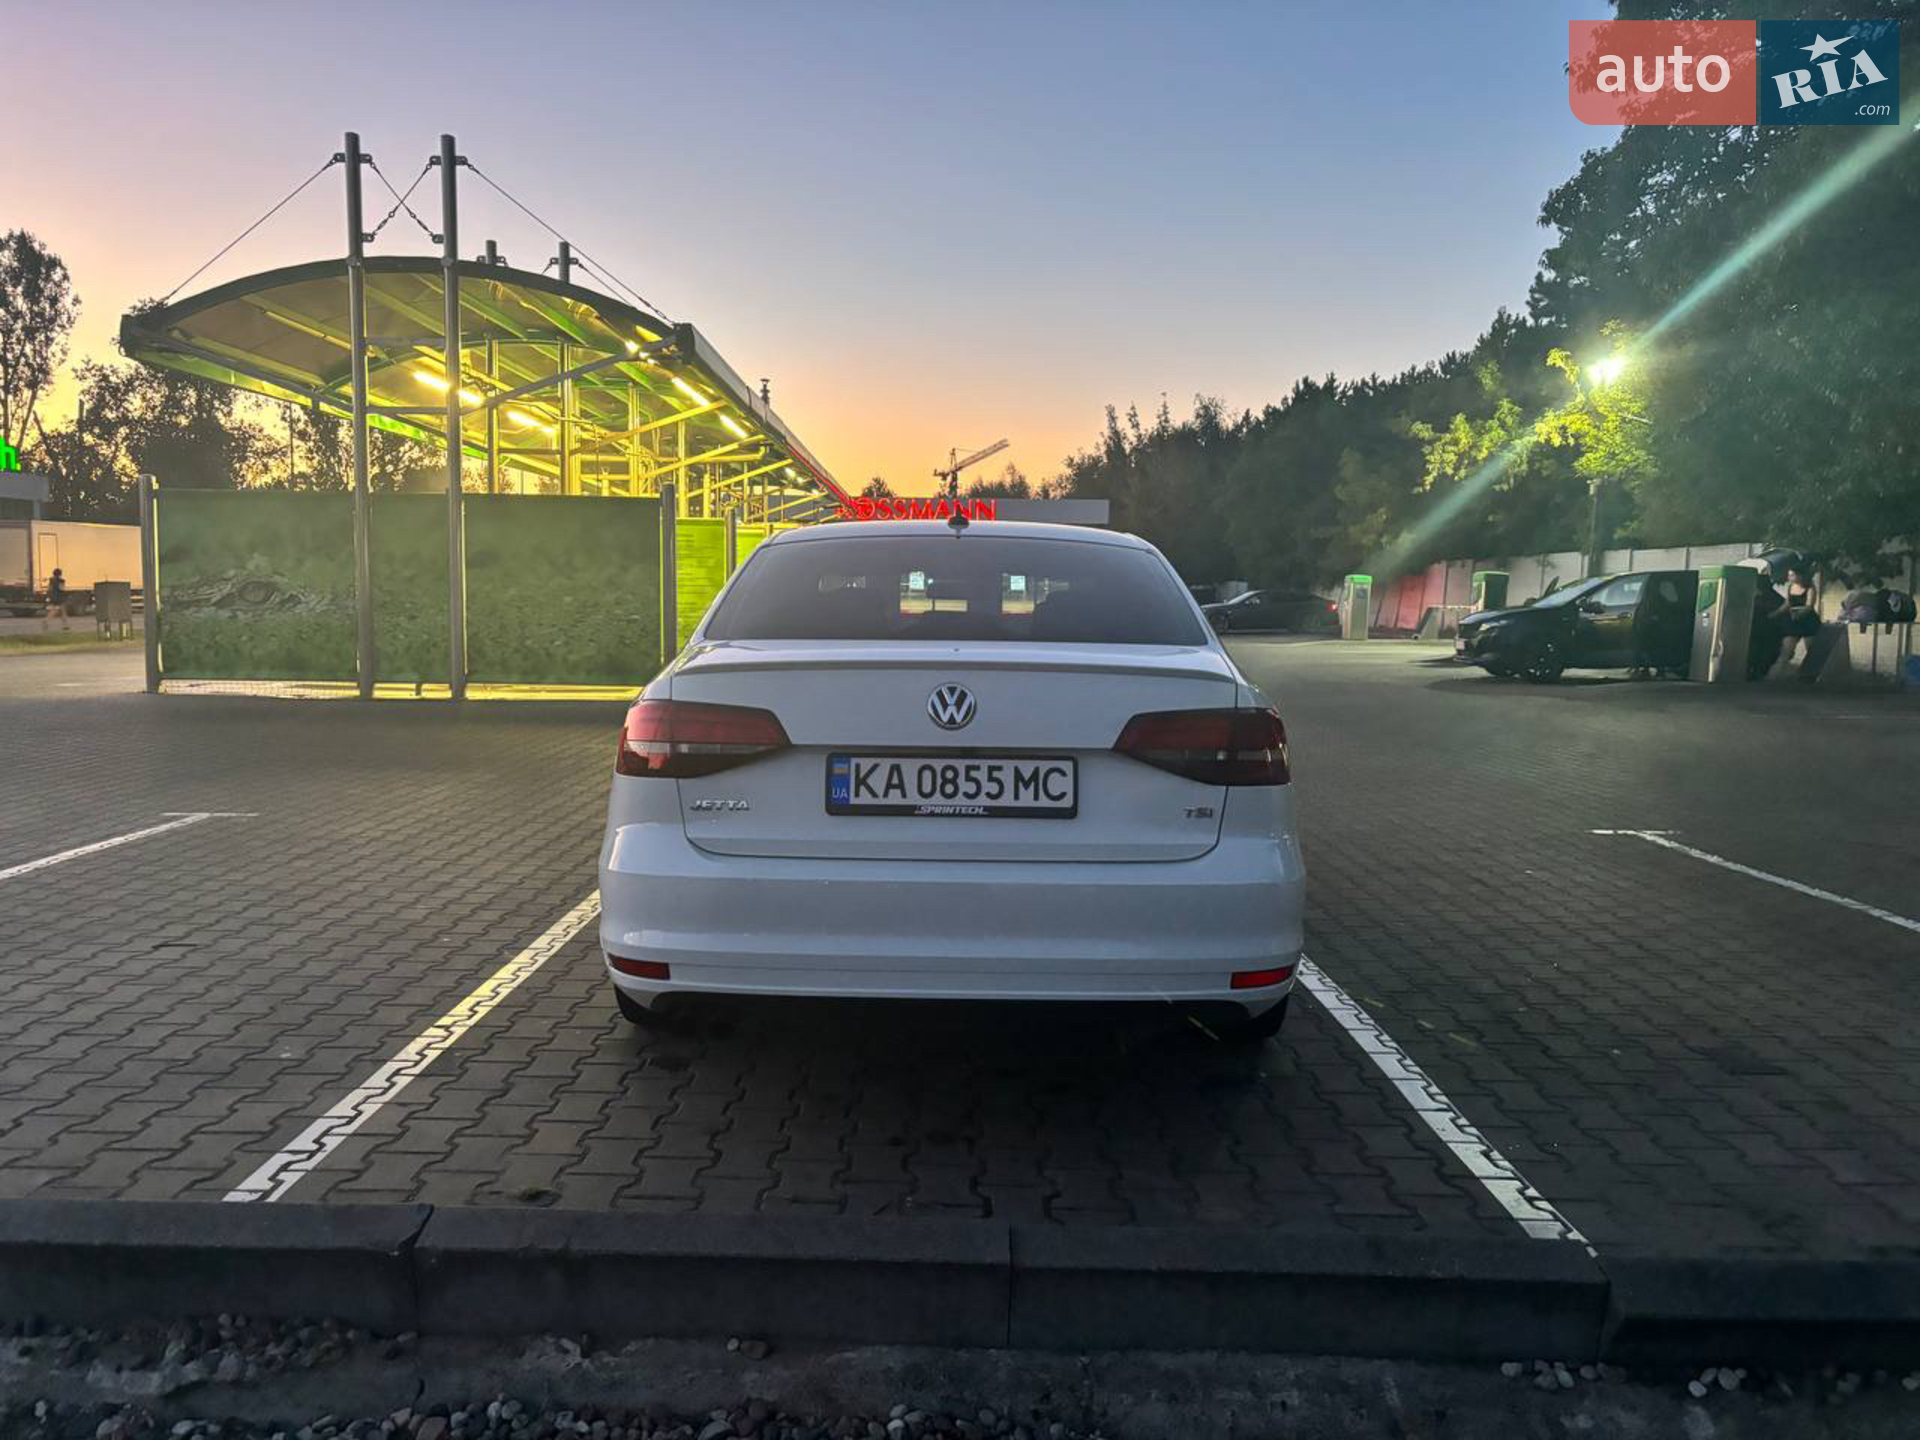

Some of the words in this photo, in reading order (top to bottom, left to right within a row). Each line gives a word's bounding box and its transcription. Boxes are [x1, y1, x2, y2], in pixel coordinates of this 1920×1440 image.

[832, 786, 848, 799] UA
[916, 763, 1005, 801] 0855
[691, 799, 750, 811] JETTA
[1183, 806, 1213, 819] TSI
